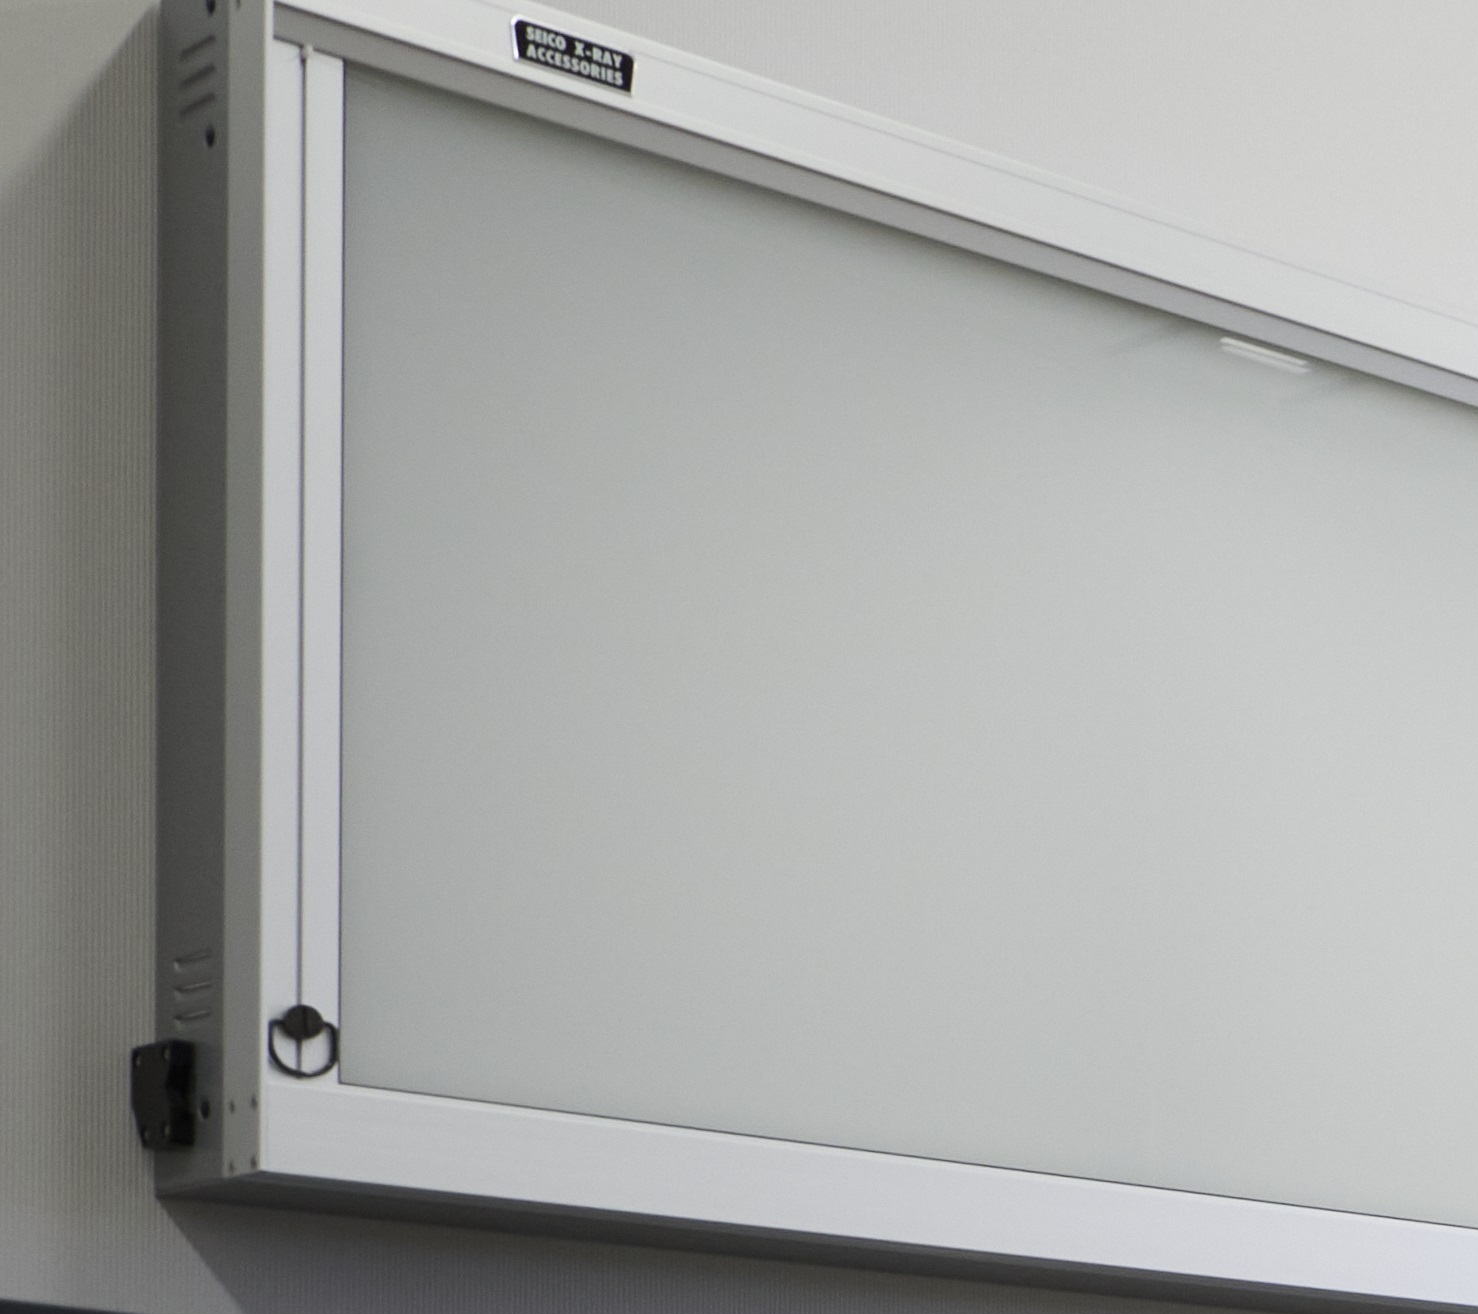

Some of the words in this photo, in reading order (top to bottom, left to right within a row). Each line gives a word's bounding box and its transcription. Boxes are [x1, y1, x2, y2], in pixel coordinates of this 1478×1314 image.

[526, 25, 567, 49] SEICO
[574, 42, 623, 69] X-RAY
[526, 44, 623, 87] ACCESSORIES
